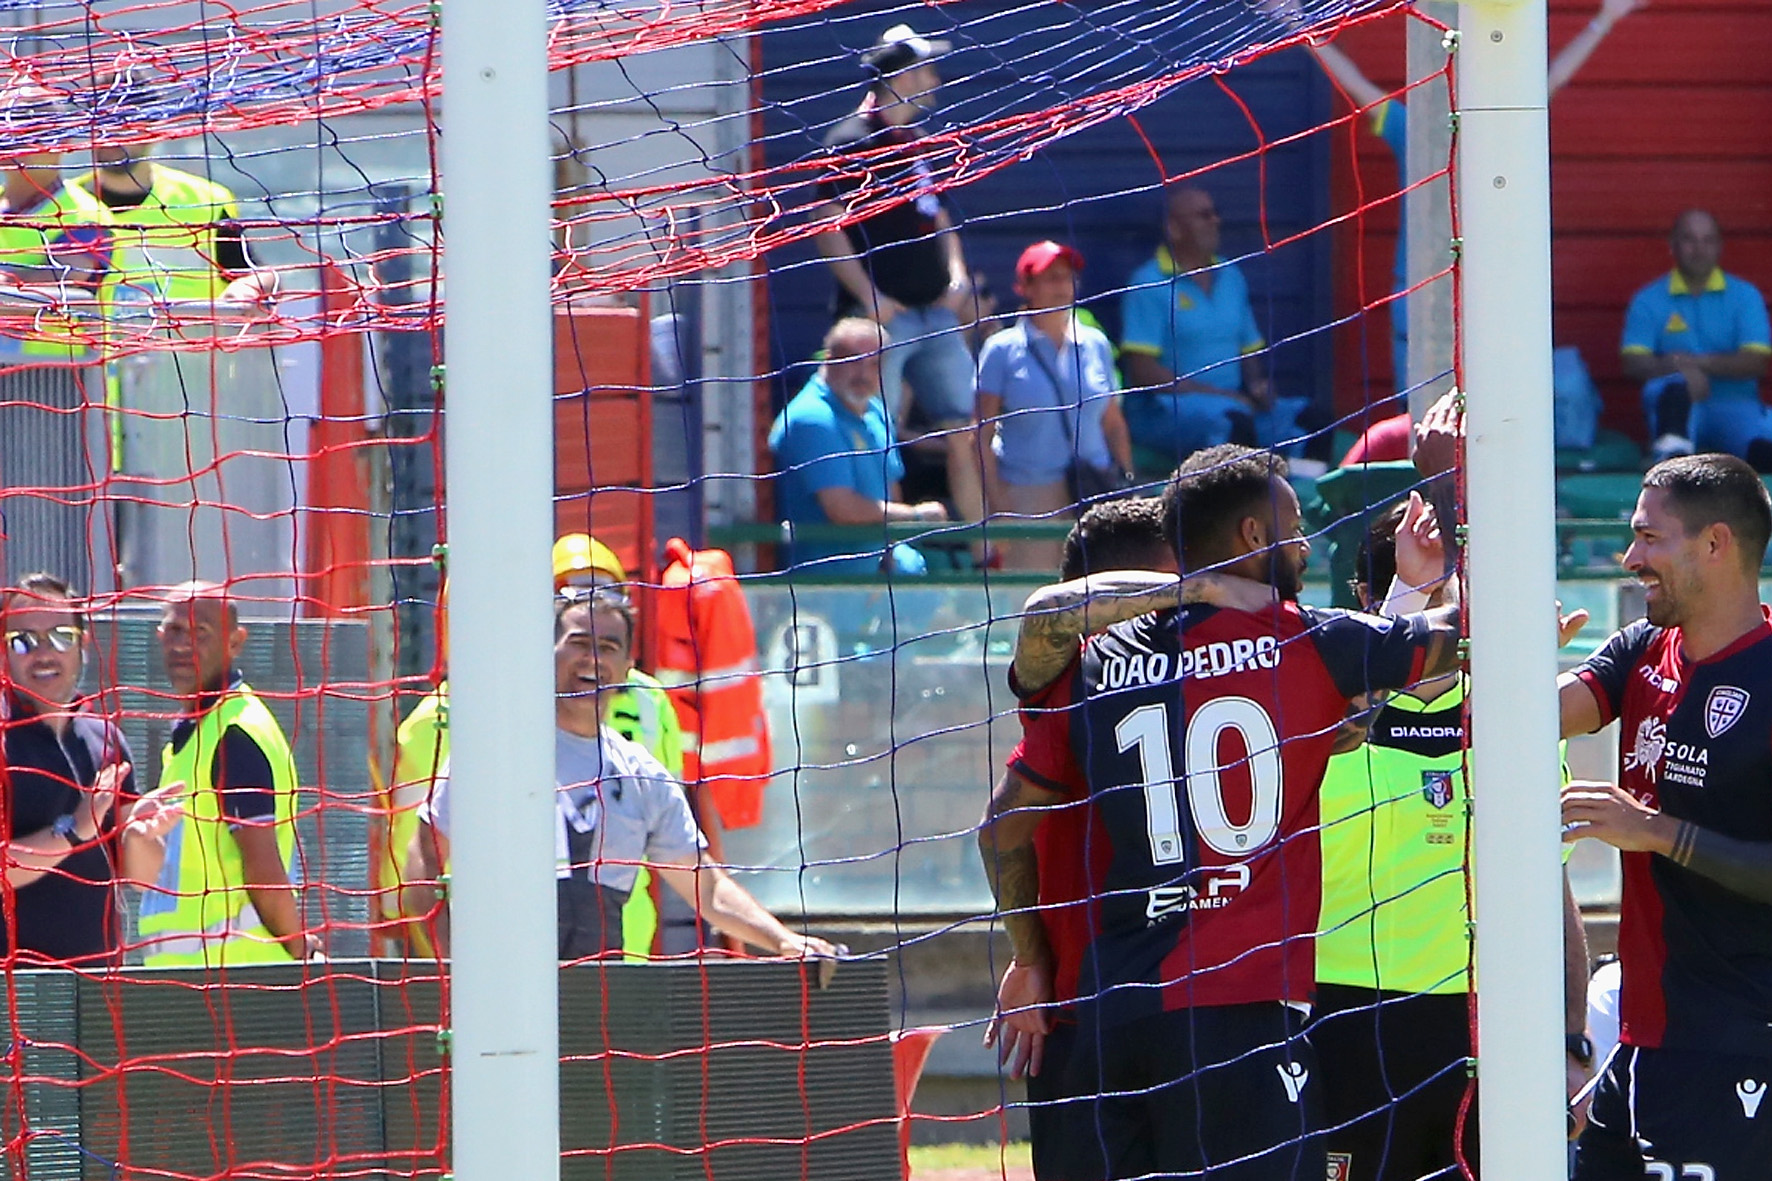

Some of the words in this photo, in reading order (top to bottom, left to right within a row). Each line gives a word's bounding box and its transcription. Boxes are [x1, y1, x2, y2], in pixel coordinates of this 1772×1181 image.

[1175, 635, 1281, 680] PEDRO
[1390, 726, 1464, 738] DIADORA
[1114, 695, 1283, 866] 10
